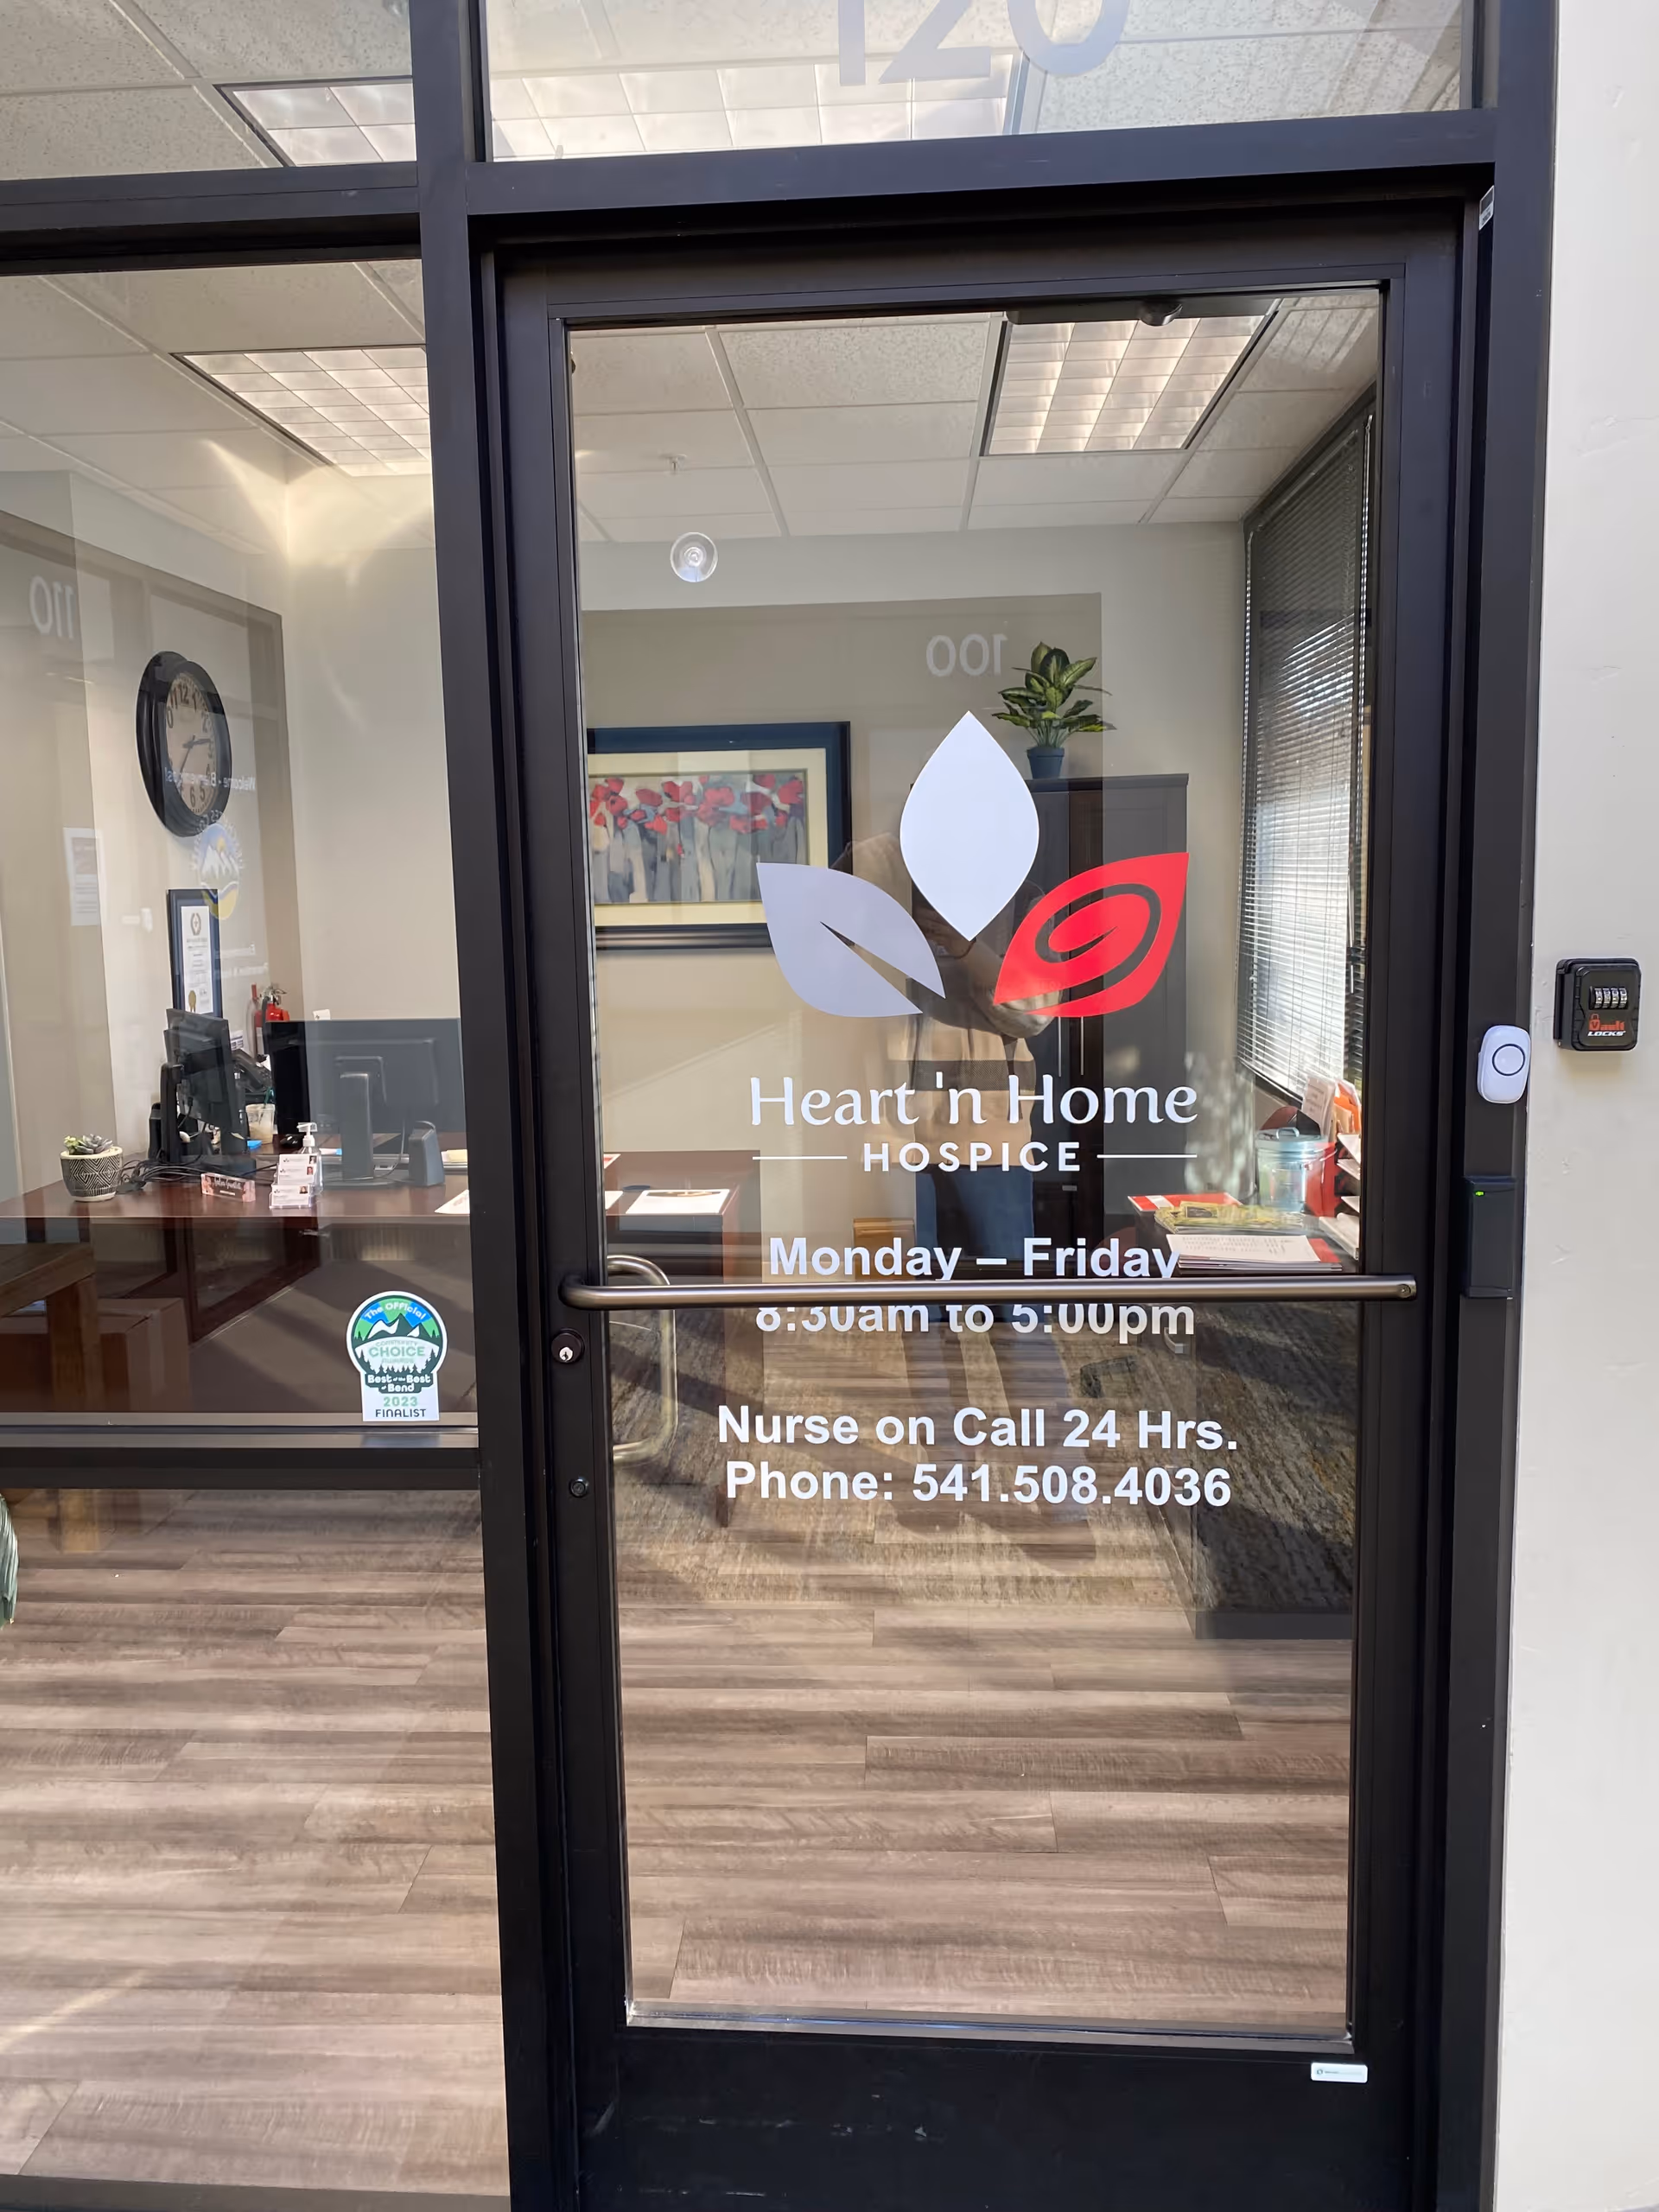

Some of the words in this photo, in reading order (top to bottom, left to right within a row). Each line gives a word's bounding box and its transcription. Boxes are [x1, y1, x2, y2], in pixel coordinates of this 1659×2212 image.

[750, 1077, 919, 1125] Heart
[1008, 1074, 1198, 1124] Home
[864, 1141, 1081, 1173] HOSPICE
[770, 1237, 962, 1281] Monday
[1023, 1237, 1181, 1279] Friday
[755, 1305, 929, 1332] 8:30am
[945, 1304, 995, 1333] to
[1011, 1303, 1195, 1344] 5:00pm
[368, 1346, 425, 1357] CHOICE
[367, 1374, 392, 1383] Best
[406, 1374, 431, 1383] Best
[387, 1383, 415, 1393] Bend
[375, 1408, 426, 1418] FINALIST
[383, 1396, 418, 1408] 2023
[718, 1406, 859, 1445] Nurse
[875, 1415, 936, 1446] on
[953, 1407, 1045, 1447] Call
[1063, 1408, 1121, 1448] 24
[1138, 1410, 1238, 1450] Hrs.
[726, 1460, 893, 1501] Phone:
[912, 1463, 1231, 1507] 541.508.4036
